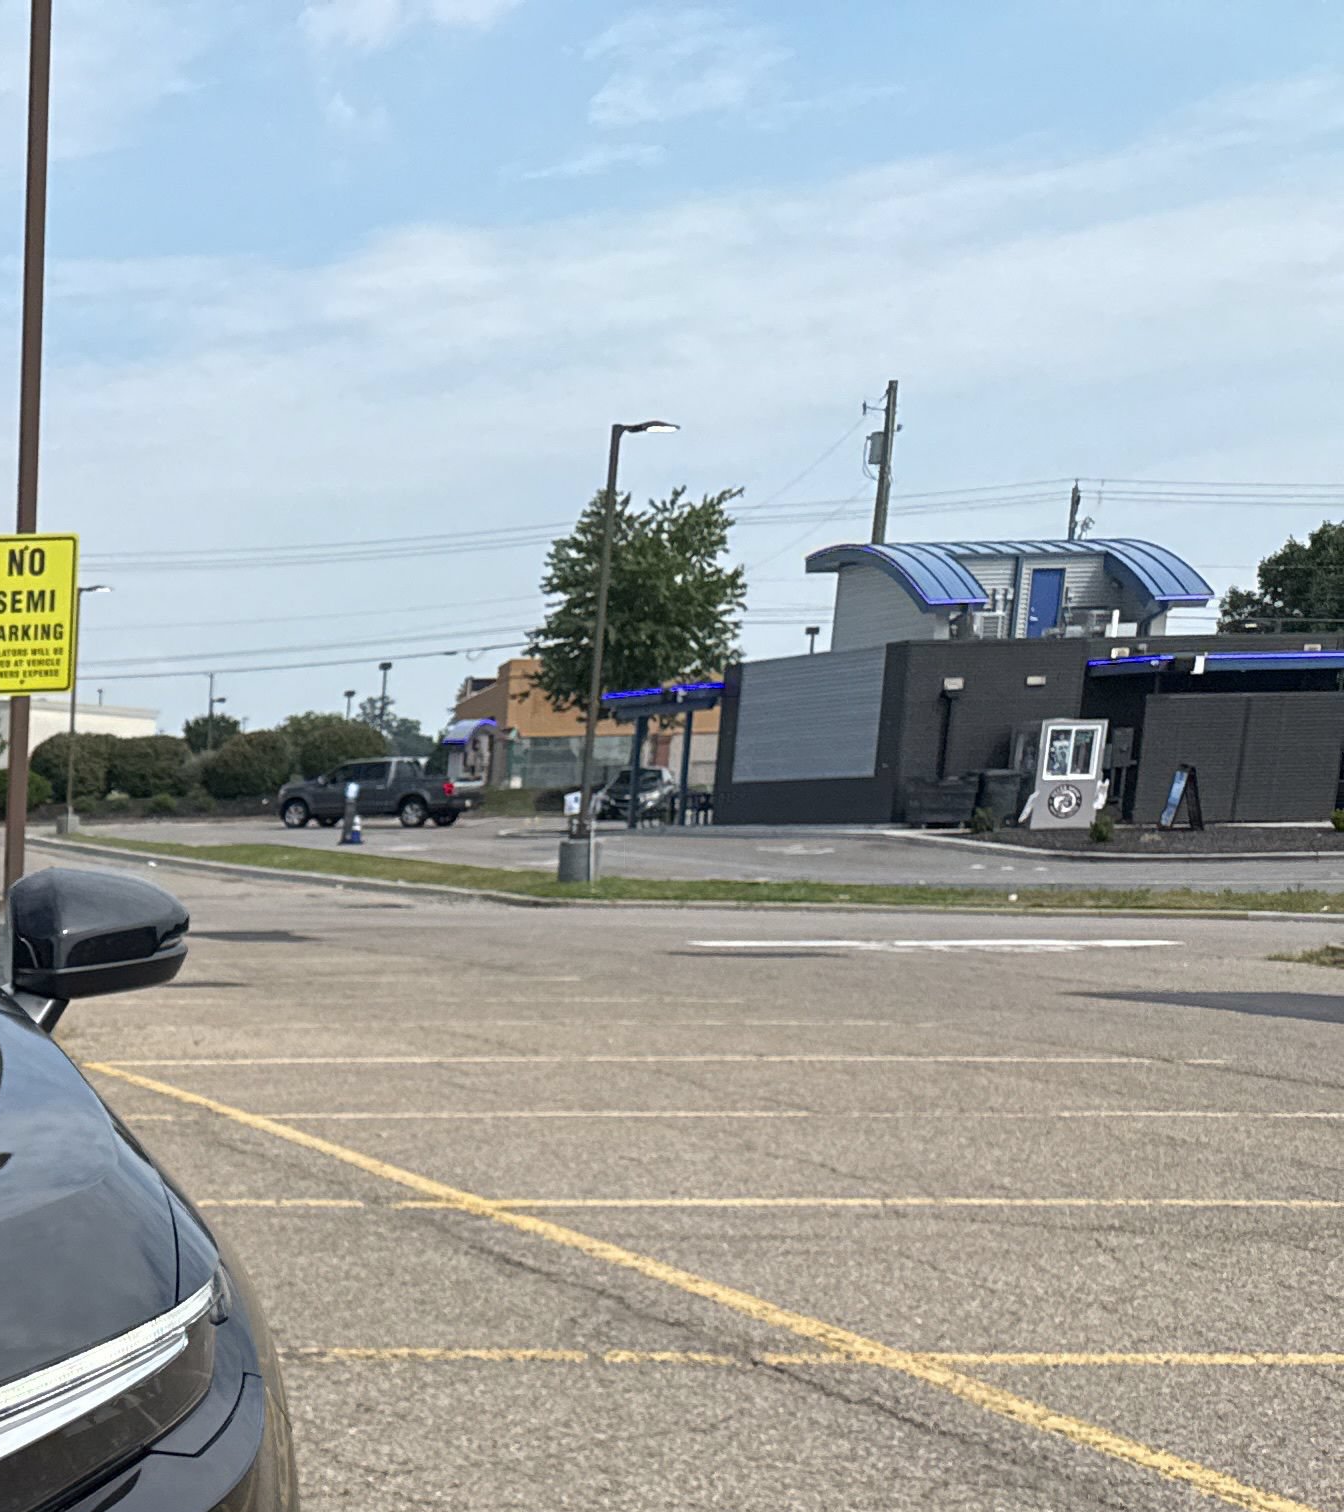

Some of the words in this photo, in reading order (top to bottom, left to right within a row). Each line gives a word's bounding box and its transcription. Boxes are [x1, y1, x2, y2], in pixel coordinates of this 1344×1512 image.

[7, 548, 45, 577] NO
[30, 648, 49, 656] WILL
[26, 658, 61, 667] VEHICLE
